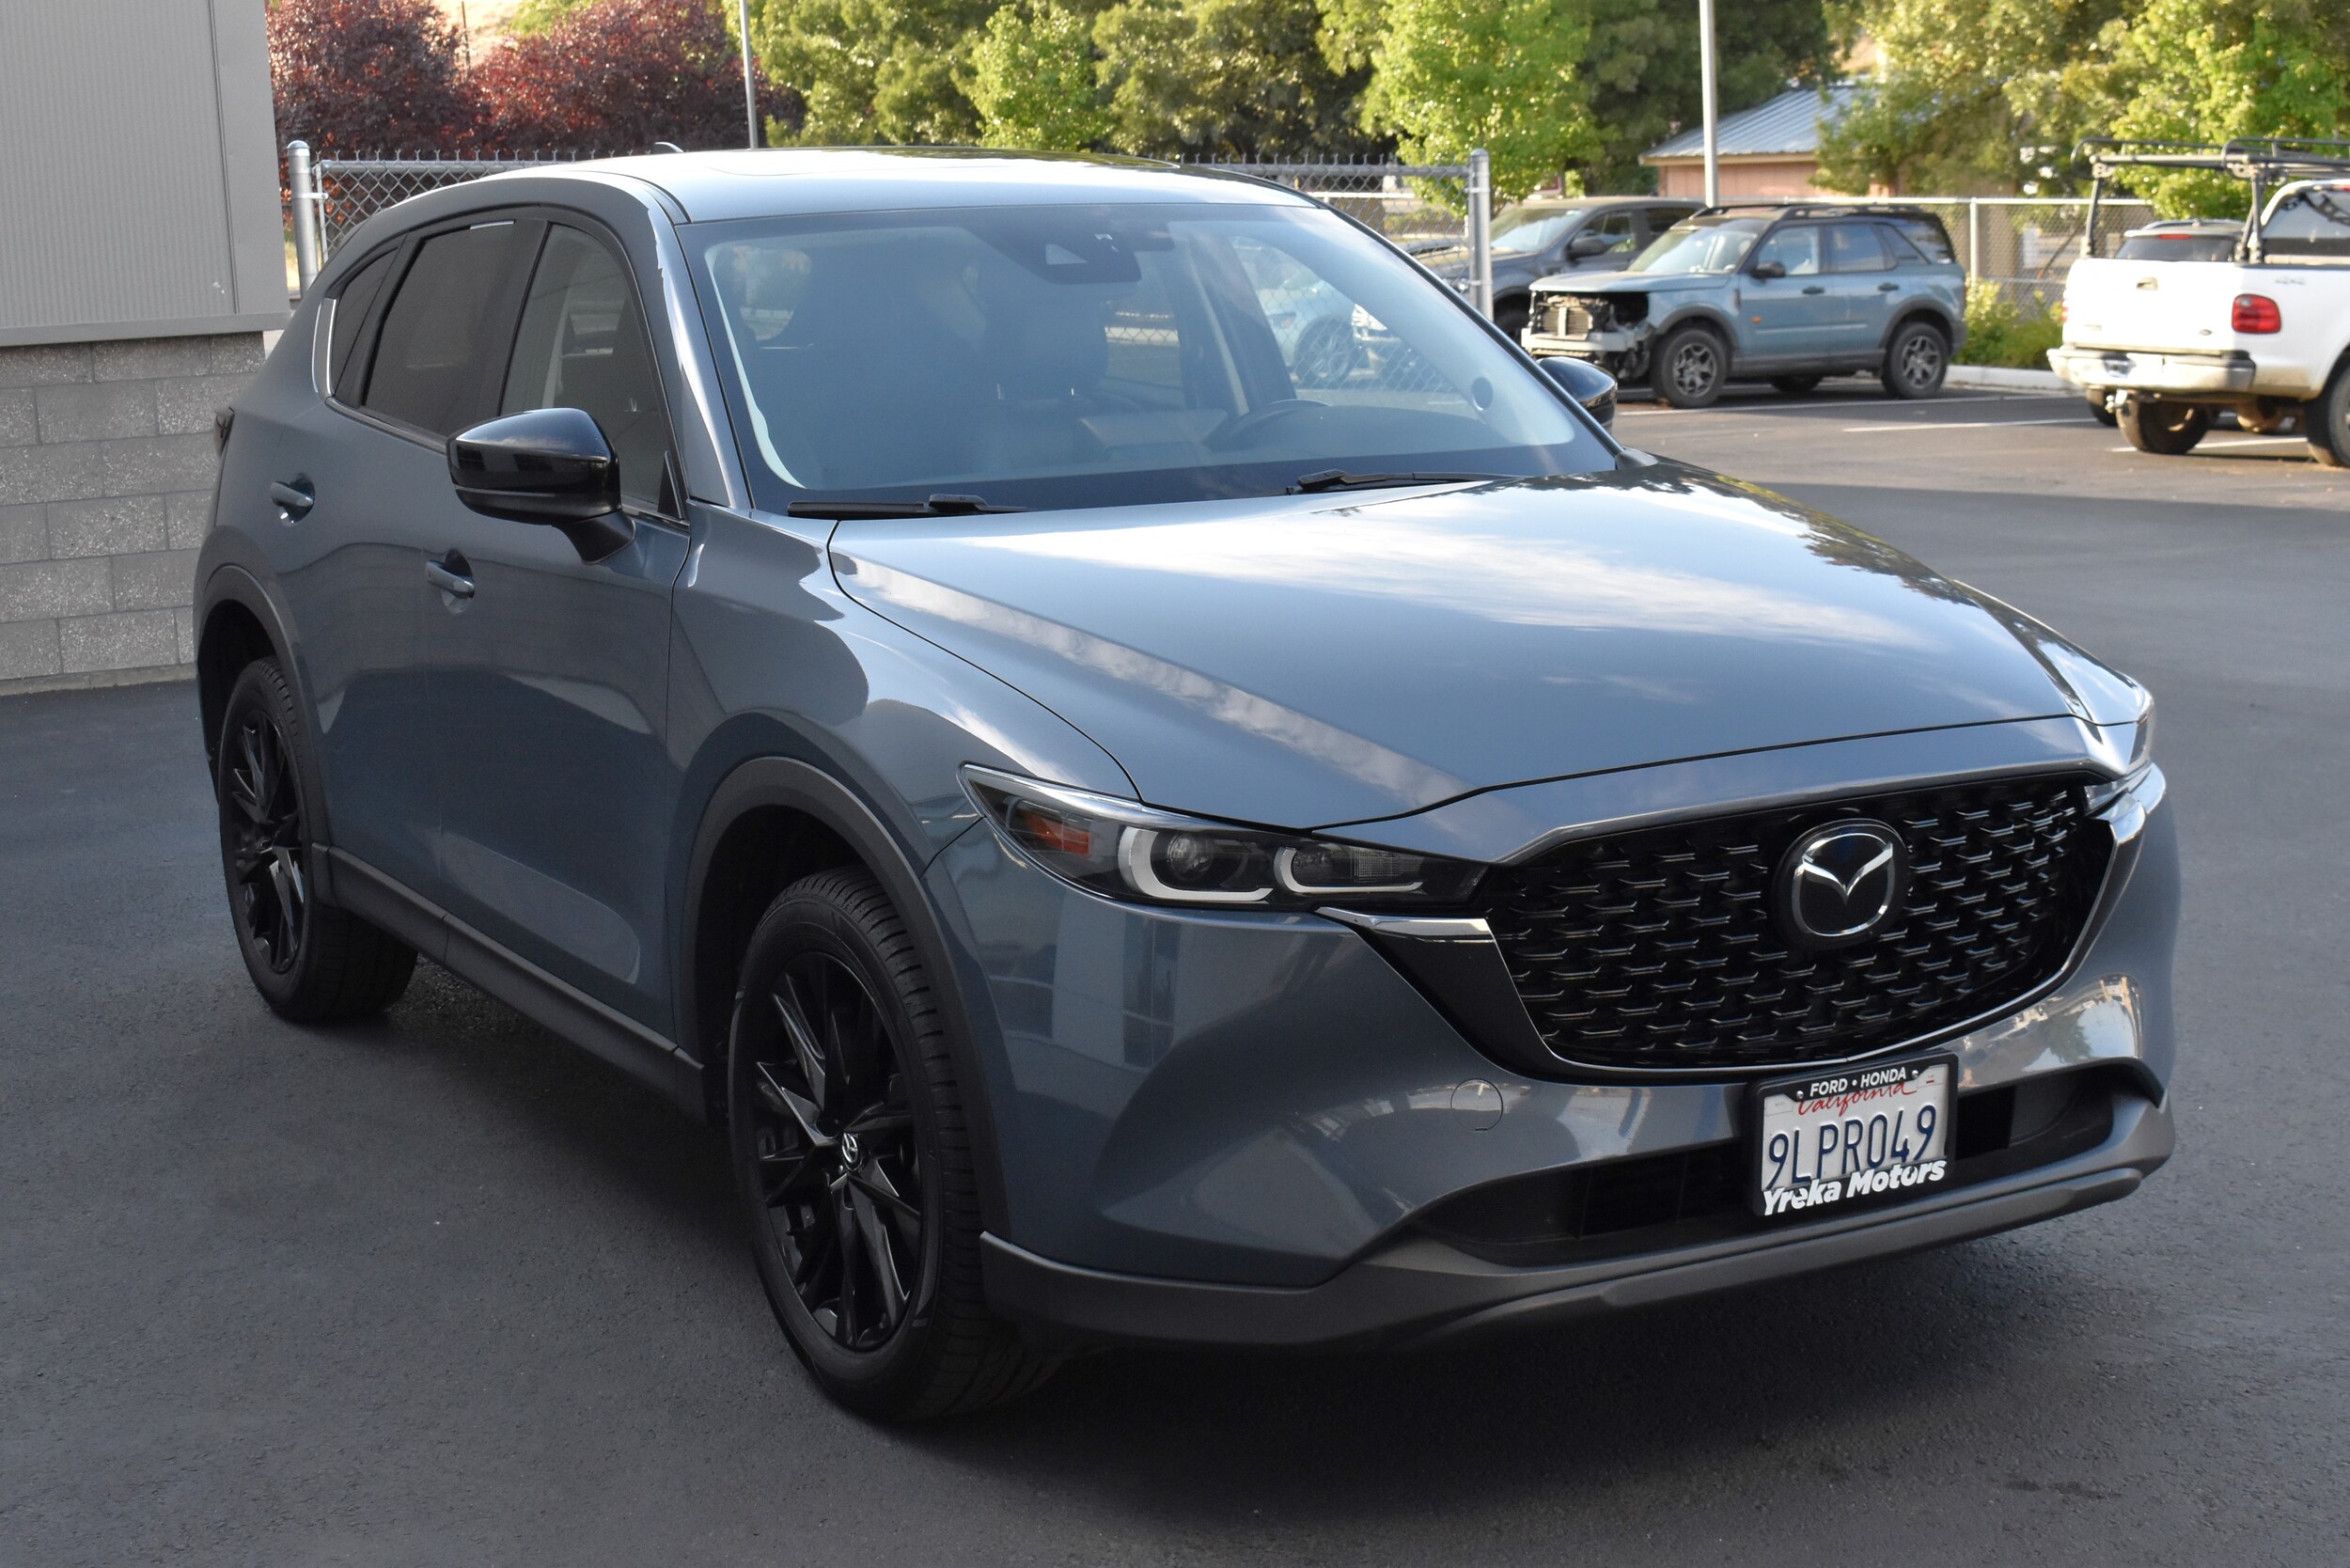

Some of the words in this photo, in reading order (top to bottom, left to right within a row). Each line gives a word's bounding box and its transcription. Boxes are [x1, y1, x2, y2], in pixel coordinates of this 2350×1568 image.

[1810, 1078, 1848, 1097] FORD
[1860, 1066, 1906, 1088] HONDA
[1768, 1105, 1936, 1189] 9LPR049
[1763, 1179, 1841, 1215] Yreka
[1846, 1160, 1947, 1198] Motors
